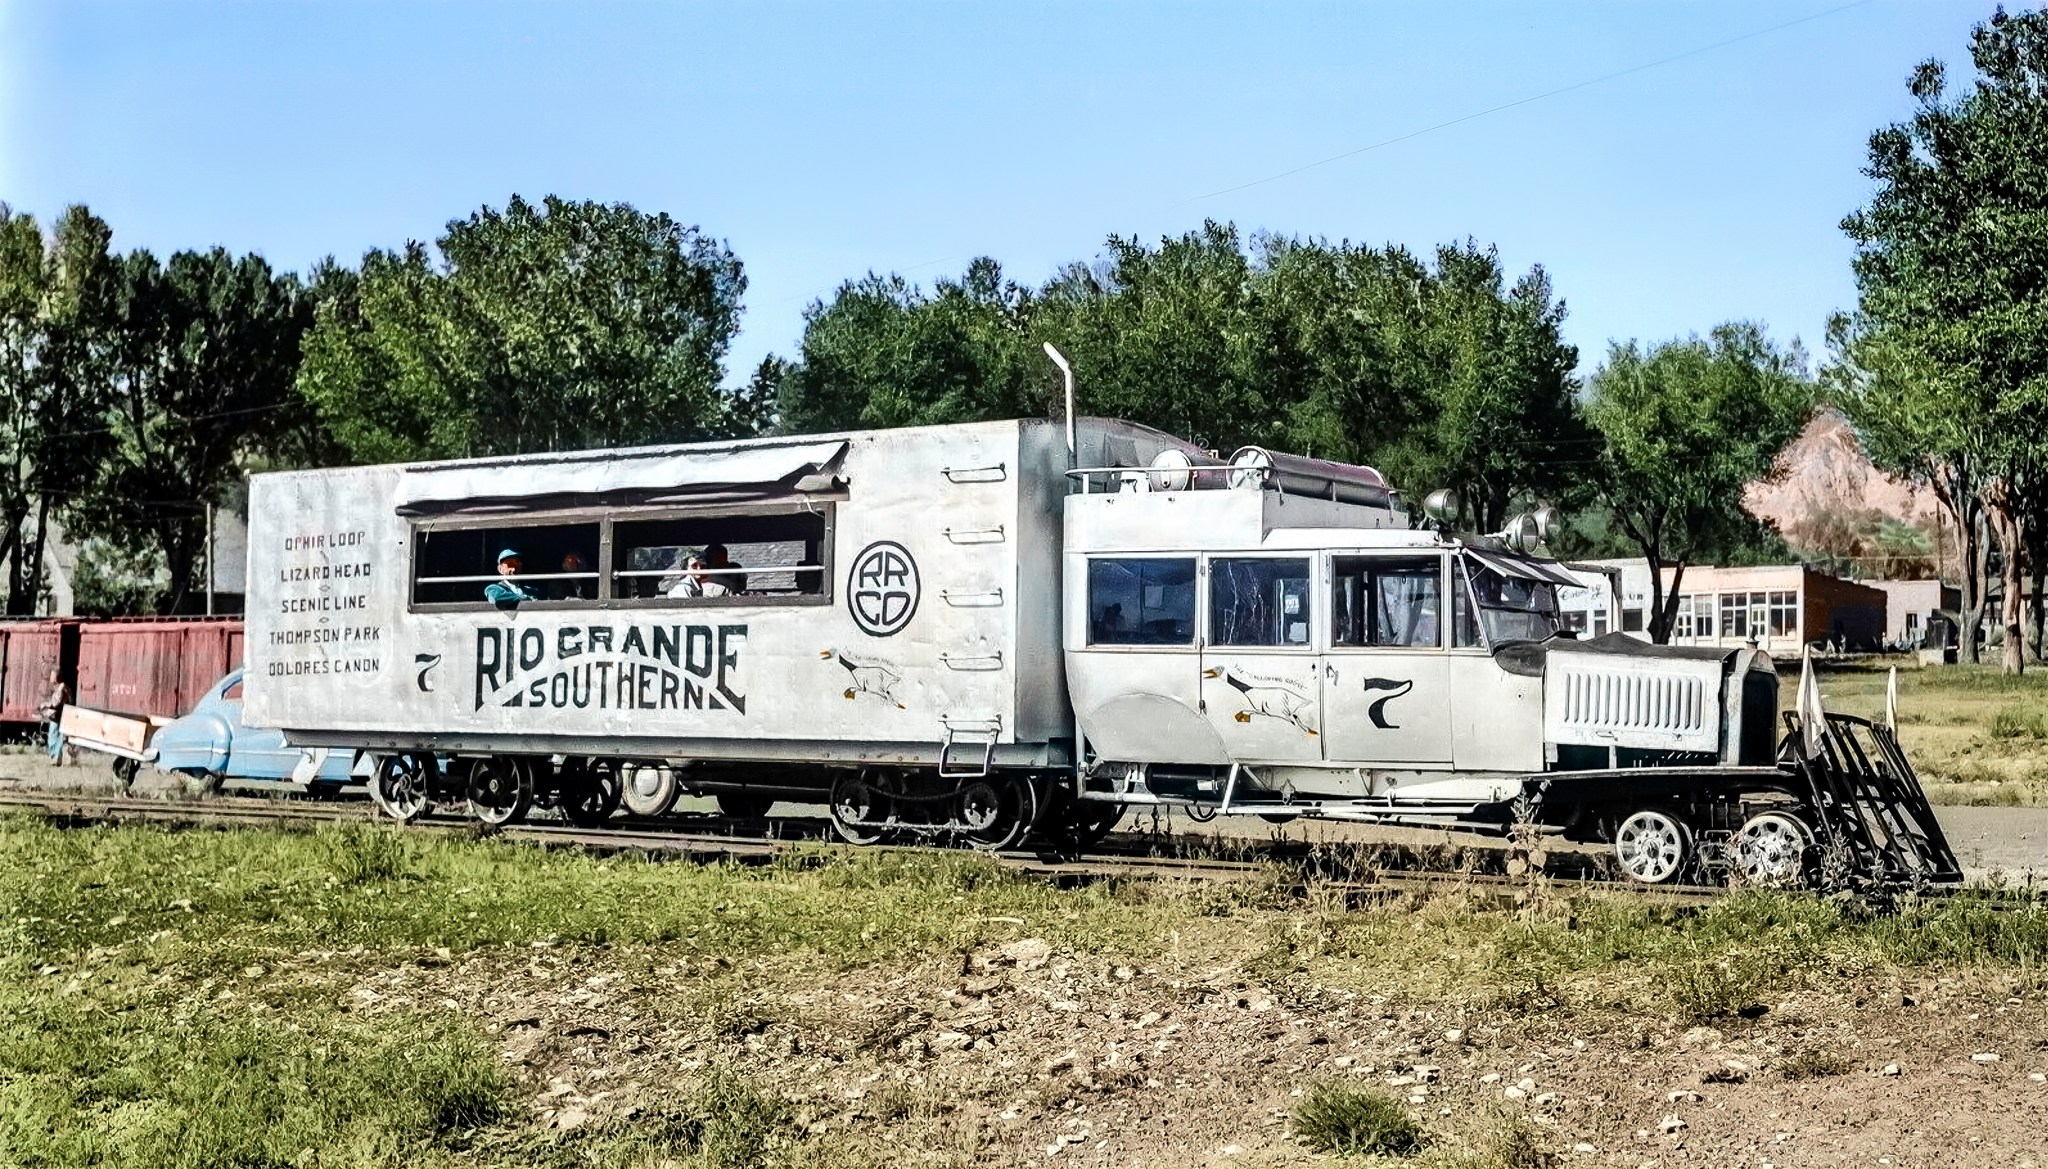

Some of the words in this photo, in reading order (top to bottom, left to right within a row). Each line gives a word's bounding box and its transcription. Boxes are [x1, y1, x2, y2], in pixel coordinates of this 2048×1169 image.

[284, 534, 325, 551] OPHIR
[329, 531, 366, 547] LOOP
[280, 565, 330, 582] LIZARD
[334, 562, 371, 578] HEAD
[281, 597, 330, 613] SCENIC
[334, 595, 366, 610] LINE
[270, 628, 340, 645] THOMPSON
[344, 626, 381, 642] PARK
[269, 660, 330, 677] DOLORES
[334, 658, 380, 674] CANON
[415, 653, 442, 692] 7
[475, 627, 544, 712] RIO
[557, 624, 748, 716] GRANDE
[529, 661, 704, 709] SOUTHERN
[1363, 677, 1413, 729] 7
